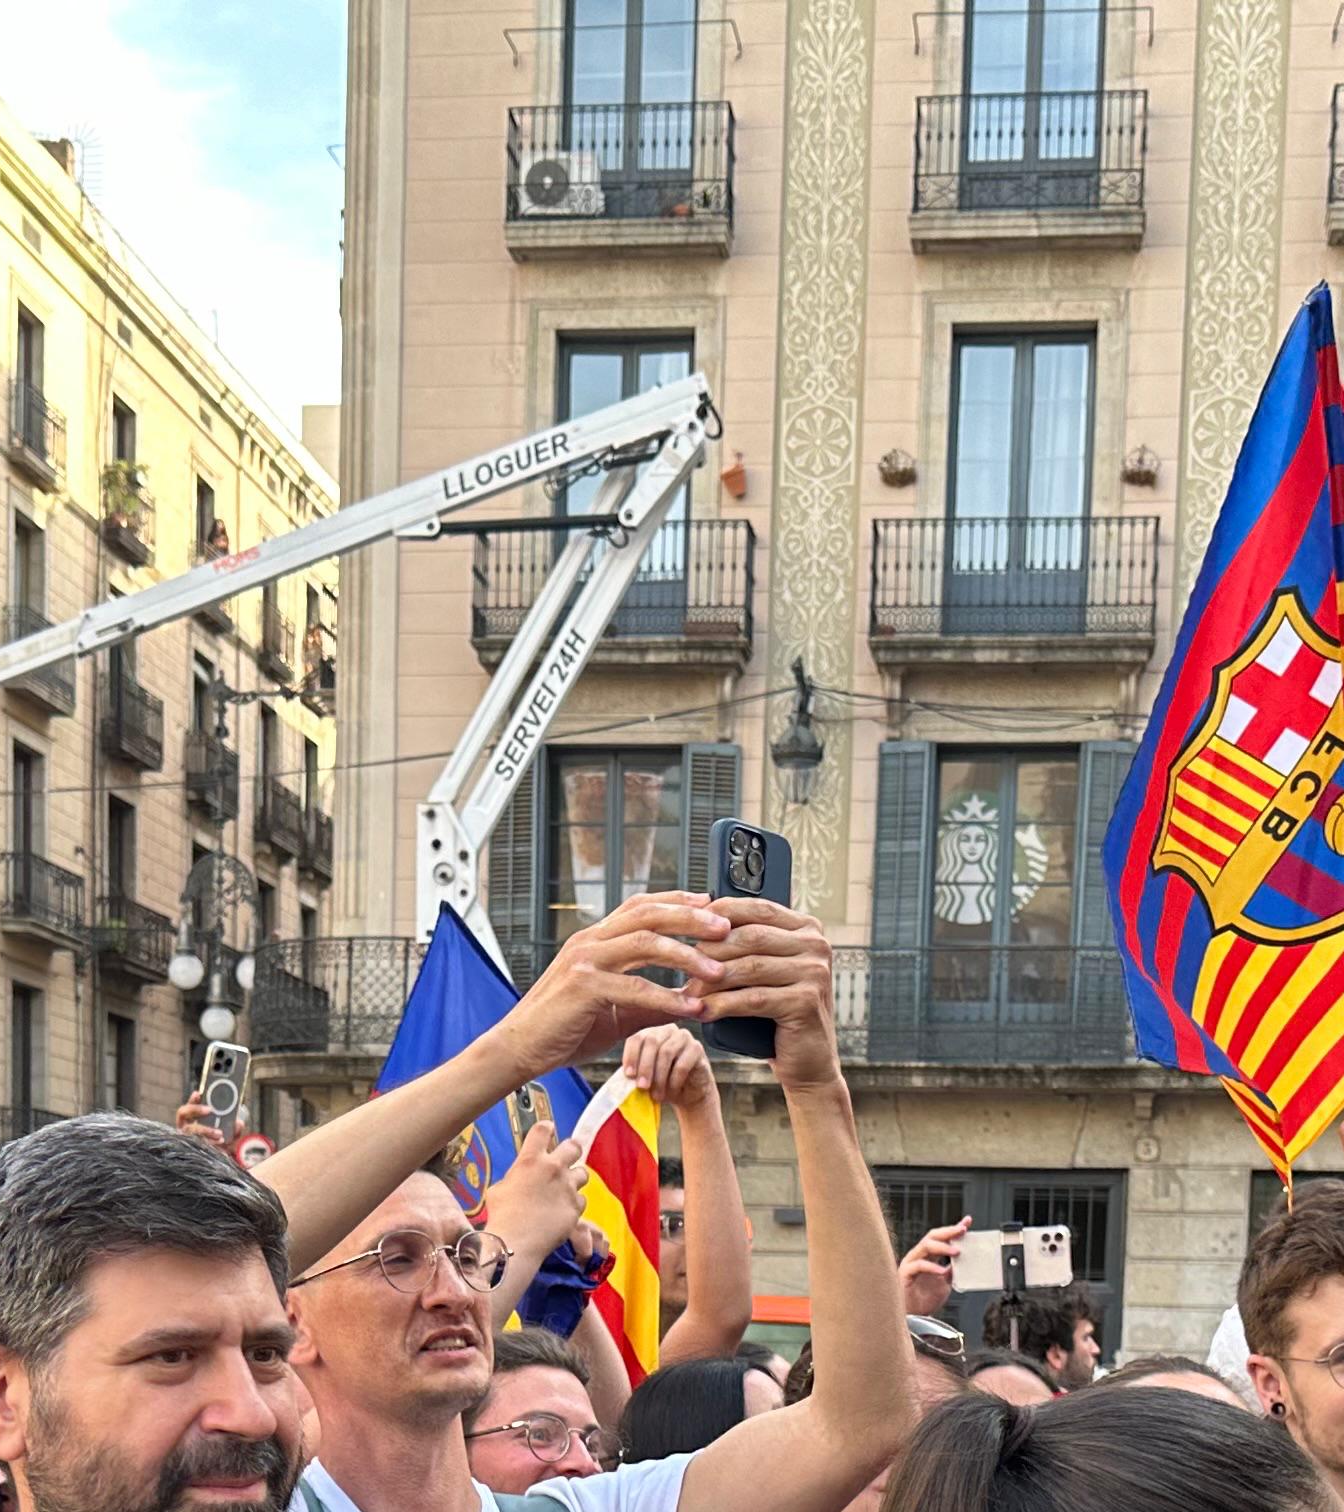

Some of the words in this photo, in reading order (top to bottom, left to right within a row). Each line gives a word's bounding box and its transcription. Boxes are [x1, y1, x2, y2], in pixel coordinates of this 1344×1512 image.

[443, 432, 570, 499] LLOGUER
[495, 682, 557, 781] SERVEI
[549, 628, 586, 684] 24H
